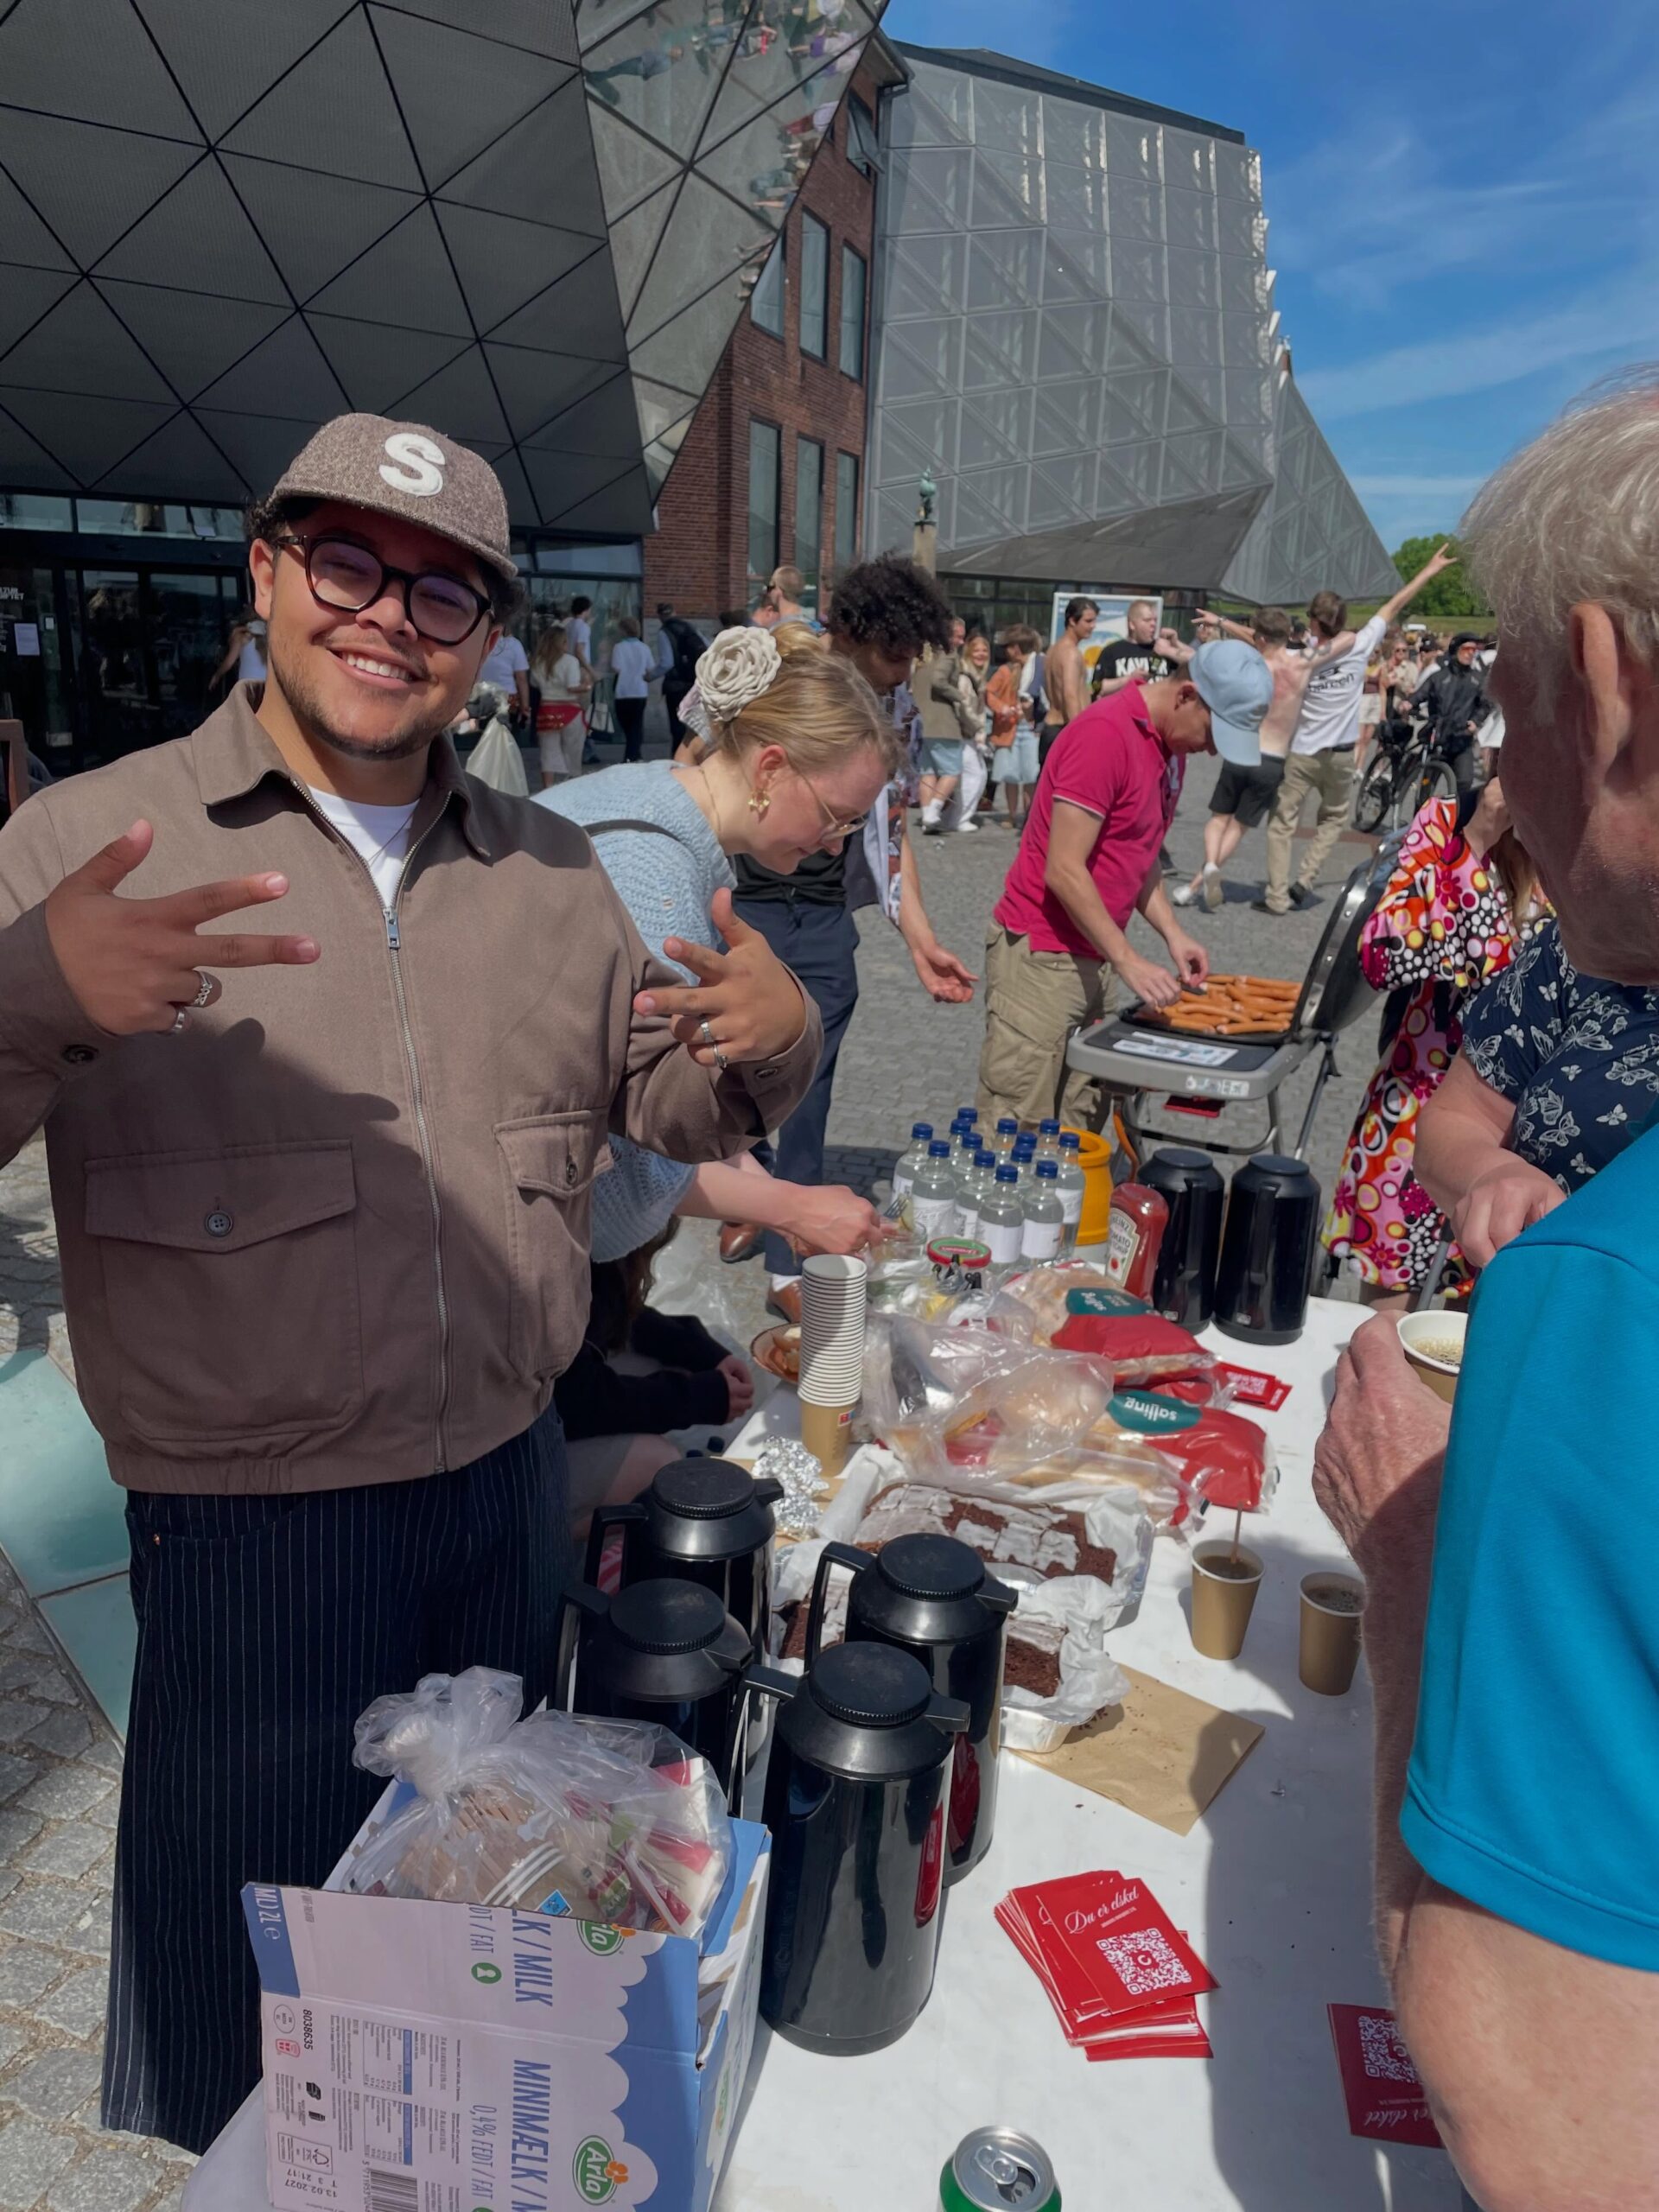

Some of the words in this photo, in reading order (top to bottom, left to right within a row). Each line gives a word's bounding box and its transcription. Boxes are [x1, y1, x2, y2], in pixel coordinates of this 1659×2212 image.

[378, 433, 446, 497] S
[1123, 1396, 1178, 1421] salling
[258, 1910, 281, 1923] 2L
[1065, 1910, 1096, 1935] Du
[1097, 1903, 1111, 1917] er
[470, 1934, 494, 1953] FAT
[513, 1953, 553, 2007] MILK
[302, 2009, 314, 2050] 8038635
[469, 2105, 497, 2137] 0,4%
[512, 2060, 551, 2184] MINIMÆLK
[471, 2139, 493, 2168] FEDT
[585, 2146, 607, 2193] Arla
[284, 2178, 338, 2198] 13.02.2027
[471, 2178, 493, 2200] FAT
